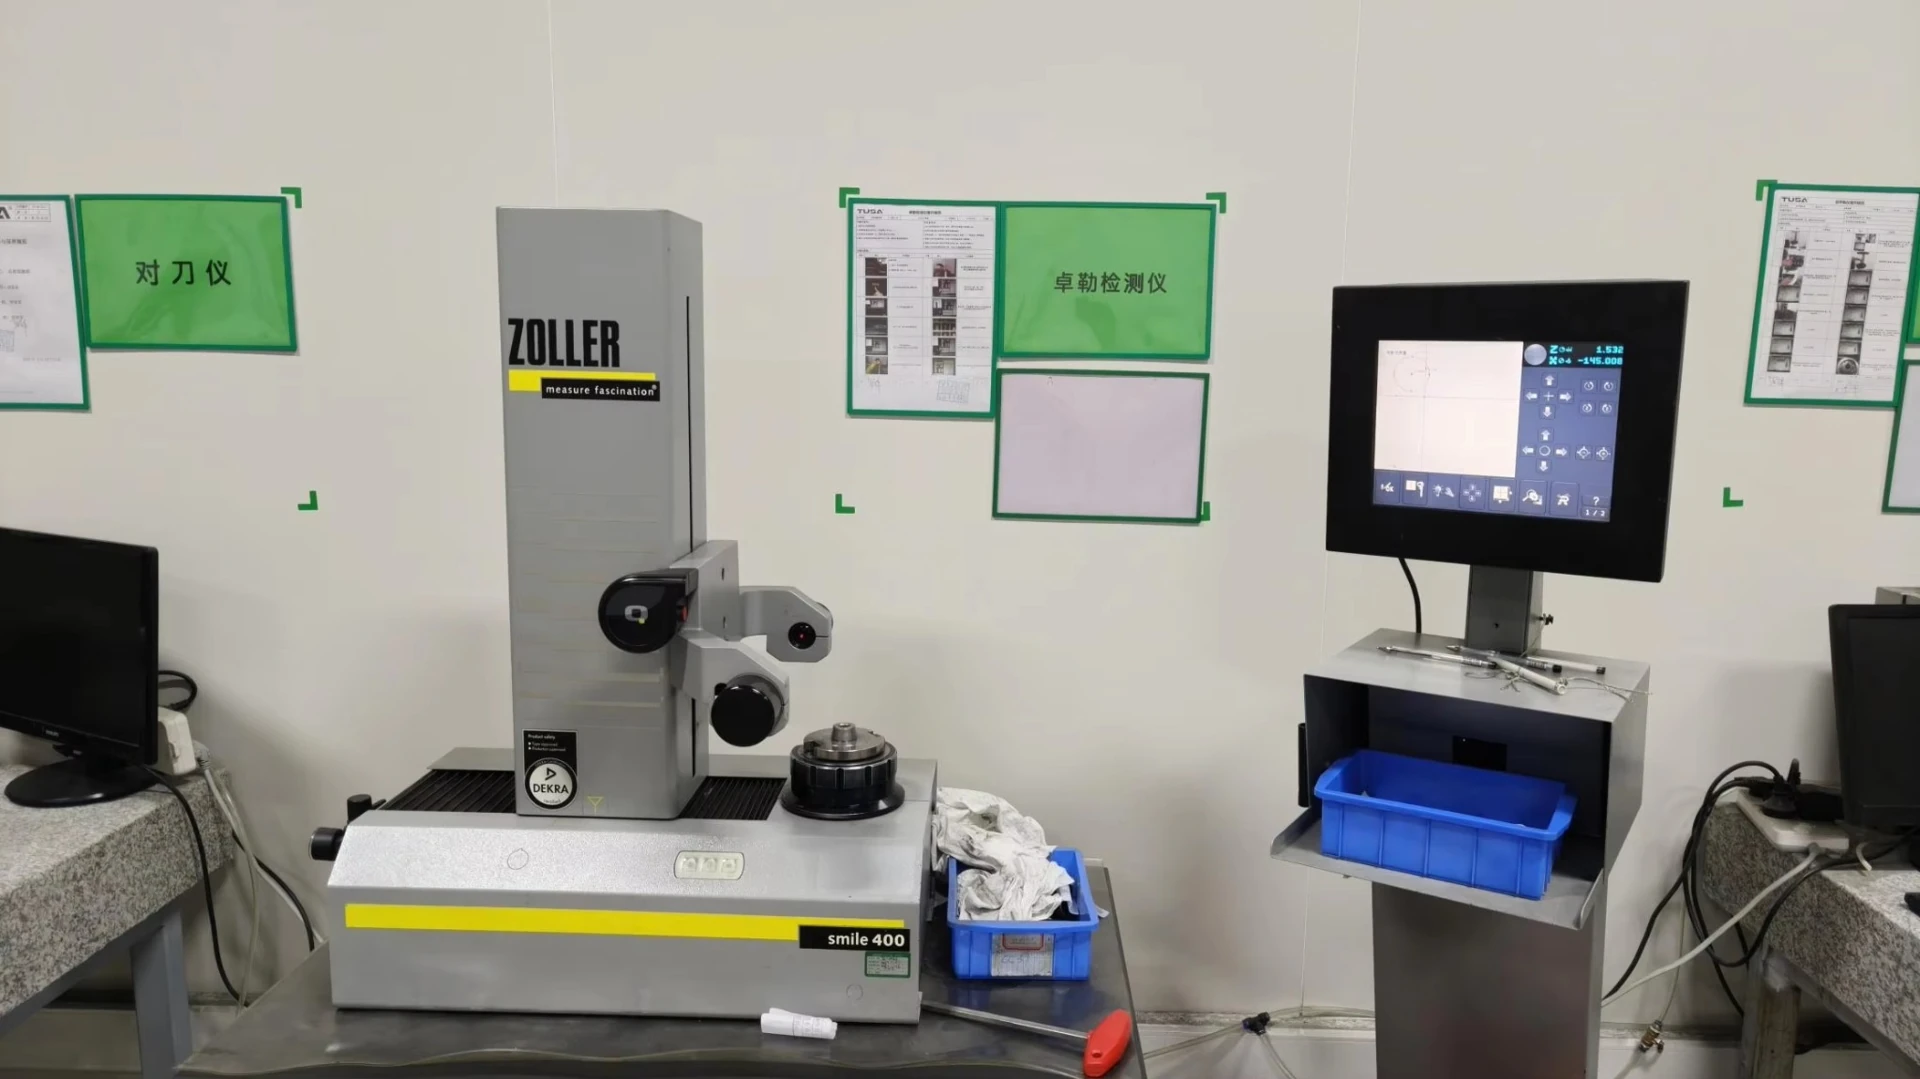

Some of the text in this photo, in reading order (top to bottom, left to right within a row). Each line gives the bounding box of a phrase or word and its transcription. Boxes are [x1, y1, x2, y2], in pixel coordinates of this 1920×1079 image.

[135, 259, 231, 286] 对刀仪
[1053, 271, 1167, 294] 卓勒检测仪
[508, 318, 620, 367] ZOLLER
[545, 385, 655, 396] measure fascination
[533, 784, 569, 794] DEKRA
[828, 932, 905, 947] smile 400
